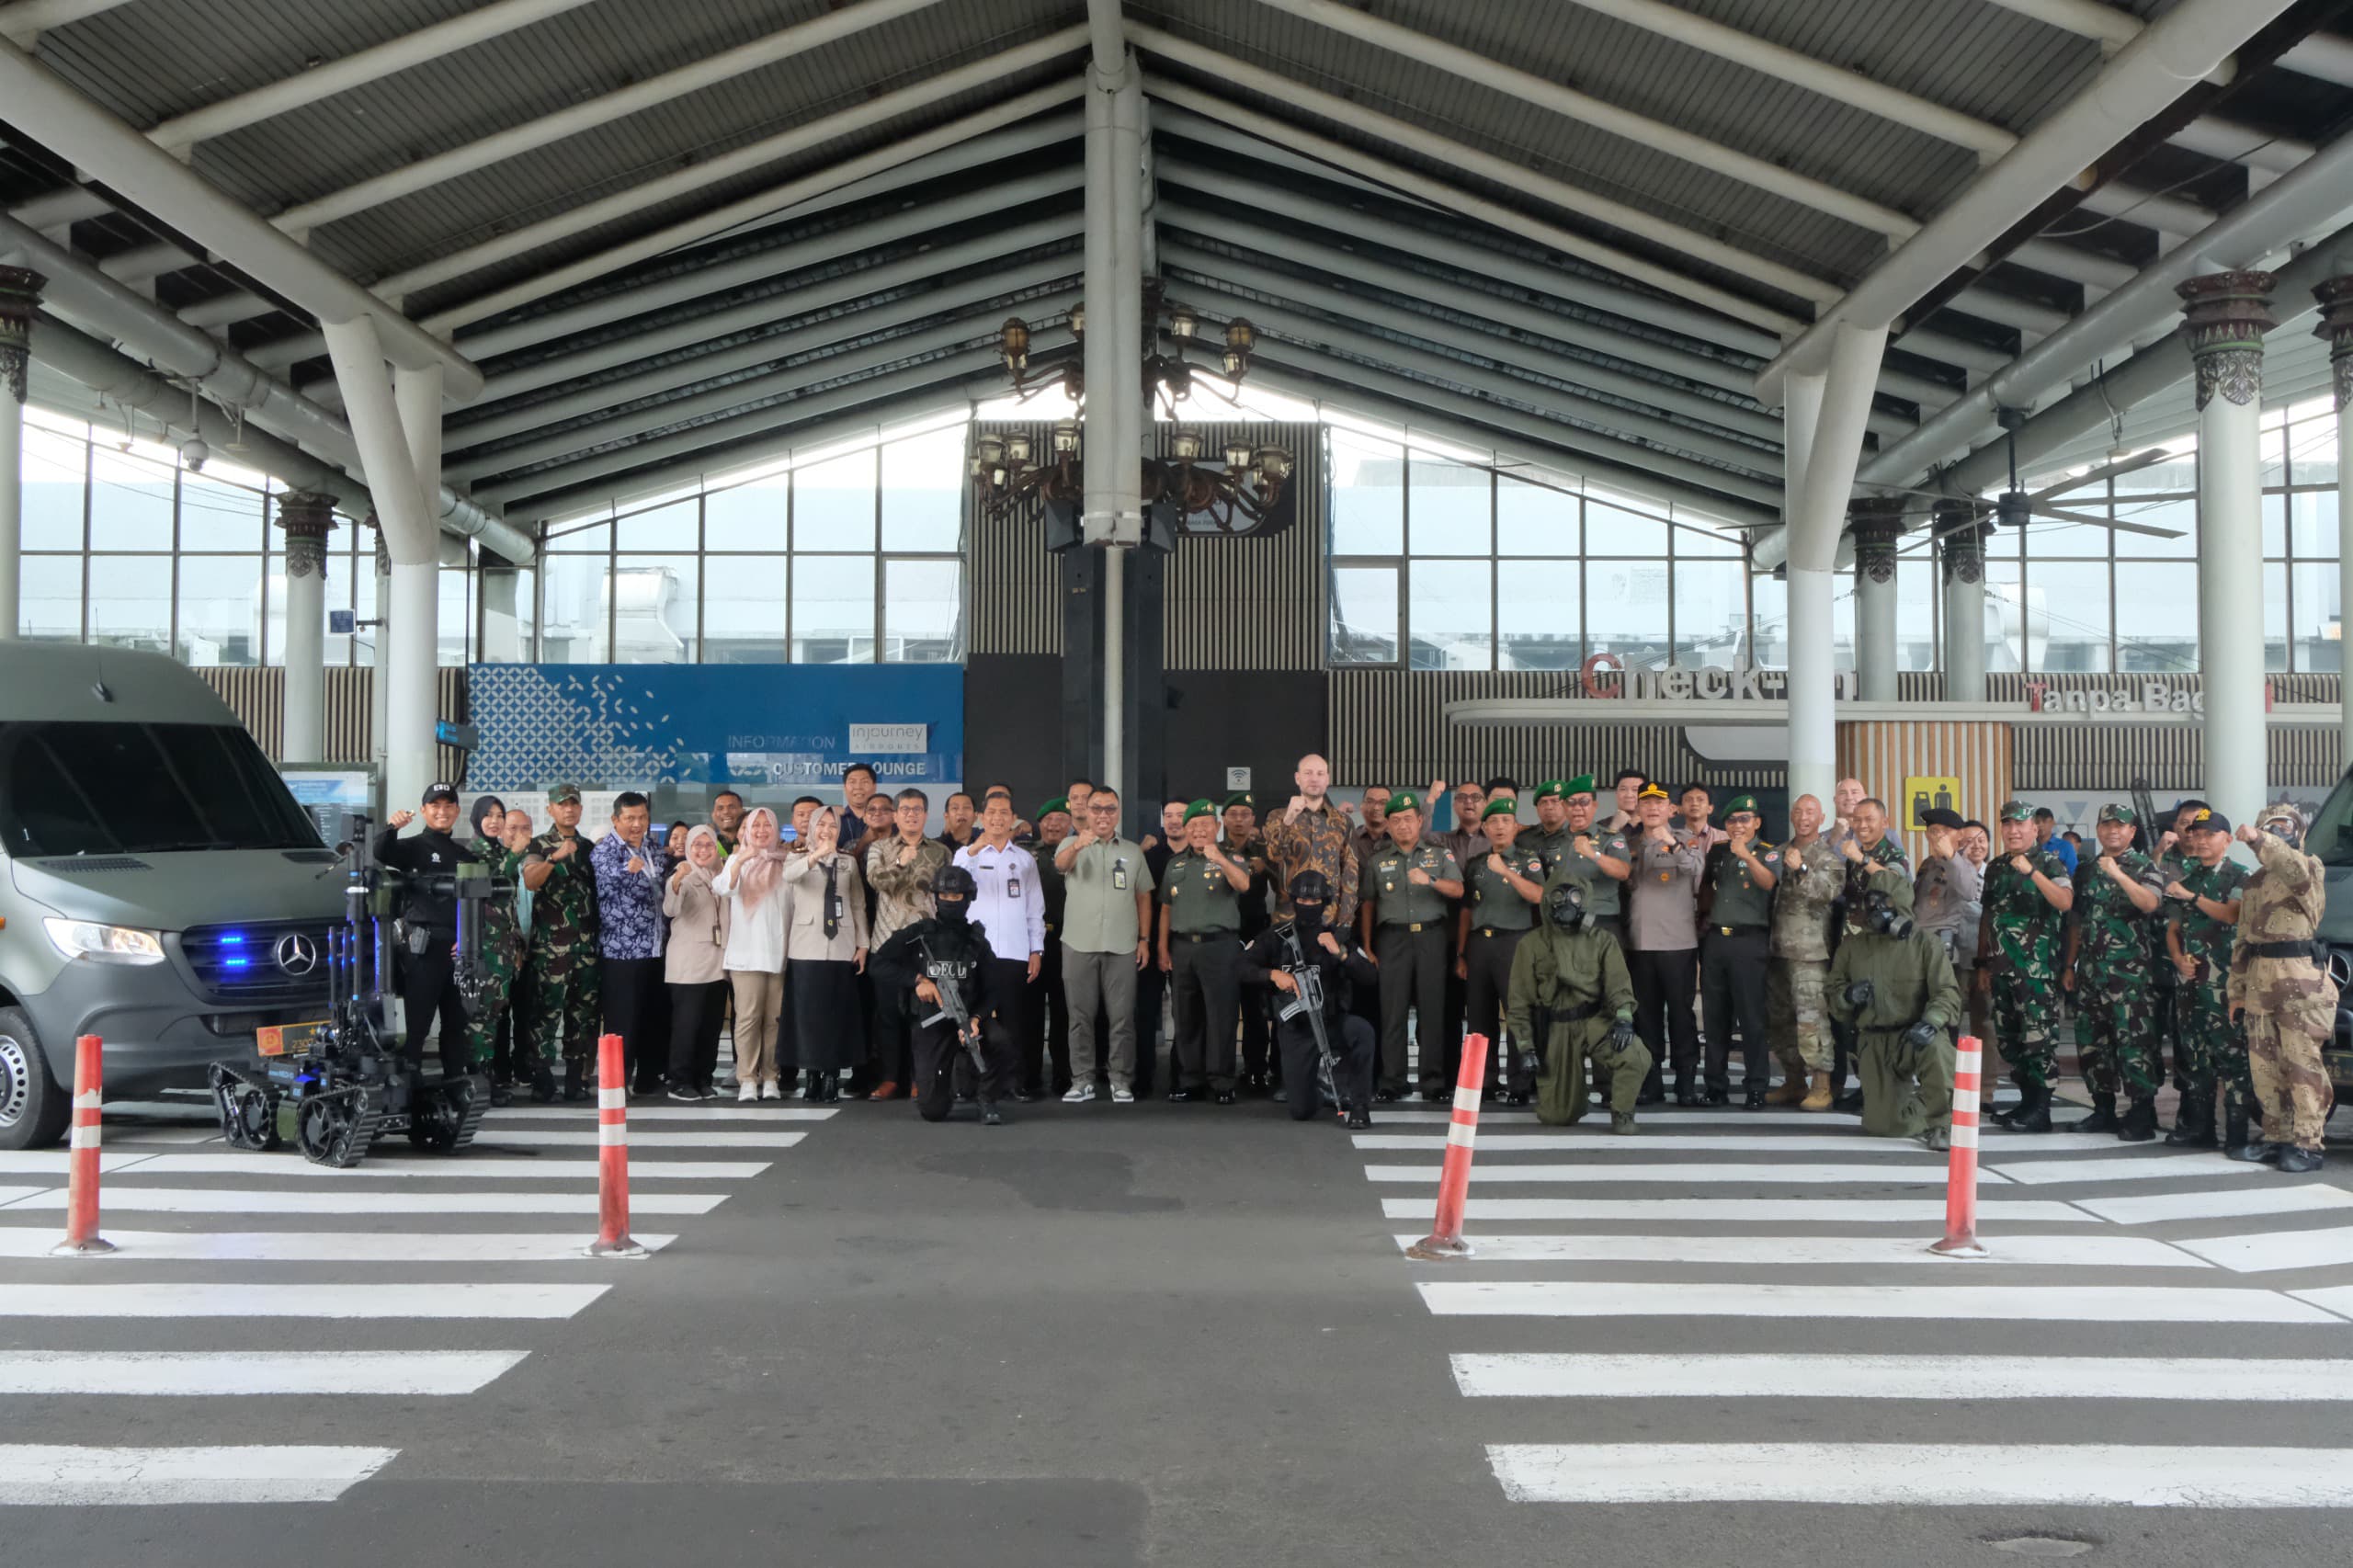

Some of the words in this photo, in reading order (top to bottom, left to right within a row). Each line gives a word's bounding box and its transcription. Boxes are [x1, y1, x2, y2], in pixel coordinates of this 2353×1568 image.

[1580, 653, 1855, 700] Check-n
[2025, 682, 2131, 720] Tanpa
[852, 726, 924, 742] injourney
[773, 761, 857, 776] CUSTOME
[870, 761, 927, 776] OUNGE
